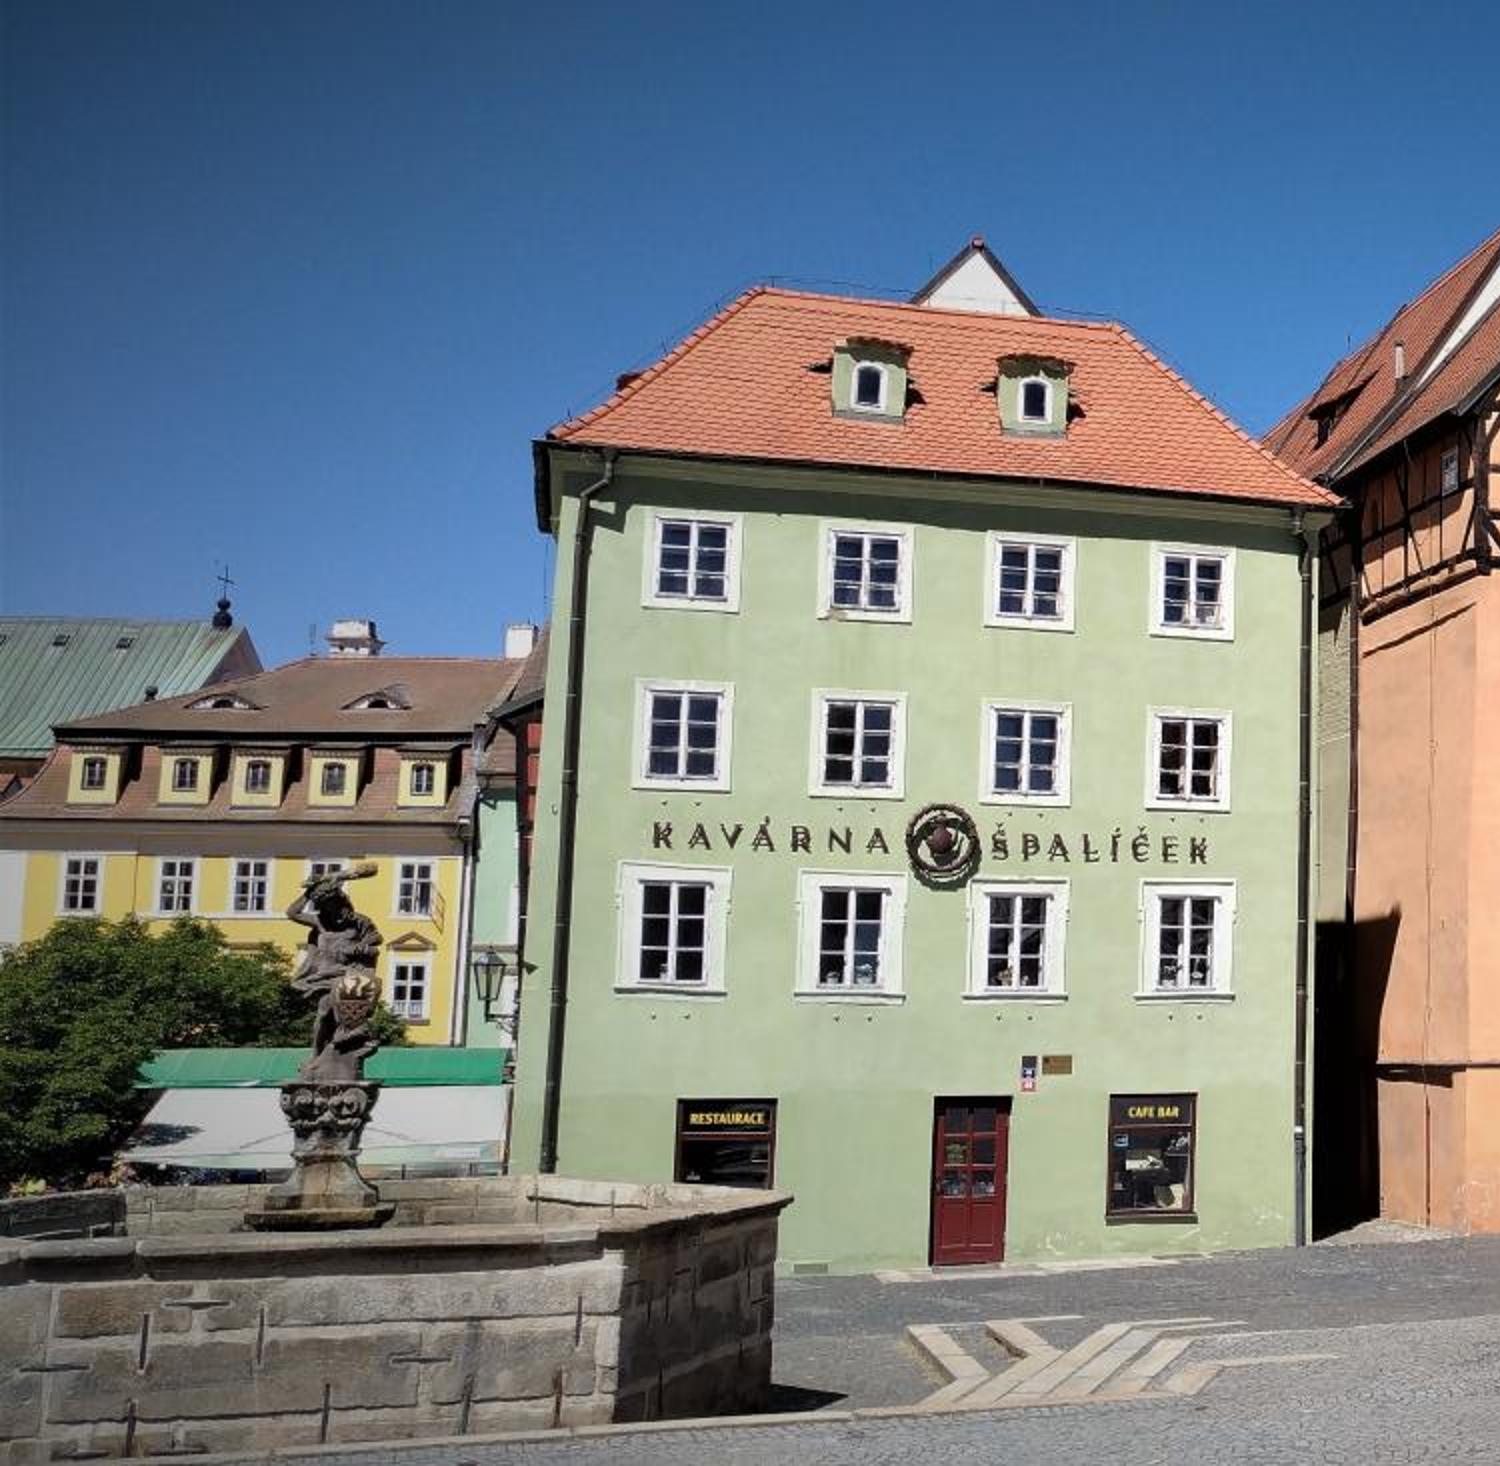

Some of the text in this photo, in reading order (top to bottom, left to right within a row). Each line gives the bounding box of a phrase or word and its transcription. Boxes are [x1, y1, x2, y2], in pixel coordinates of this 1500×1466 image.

[652, 815, 1208, 865] KAVÁRNA ŠPALÍČEK
[689, 1111, 766, 1125] RESTAURACE
[1127, 1105, 1180, 1118] CAFE BAR
